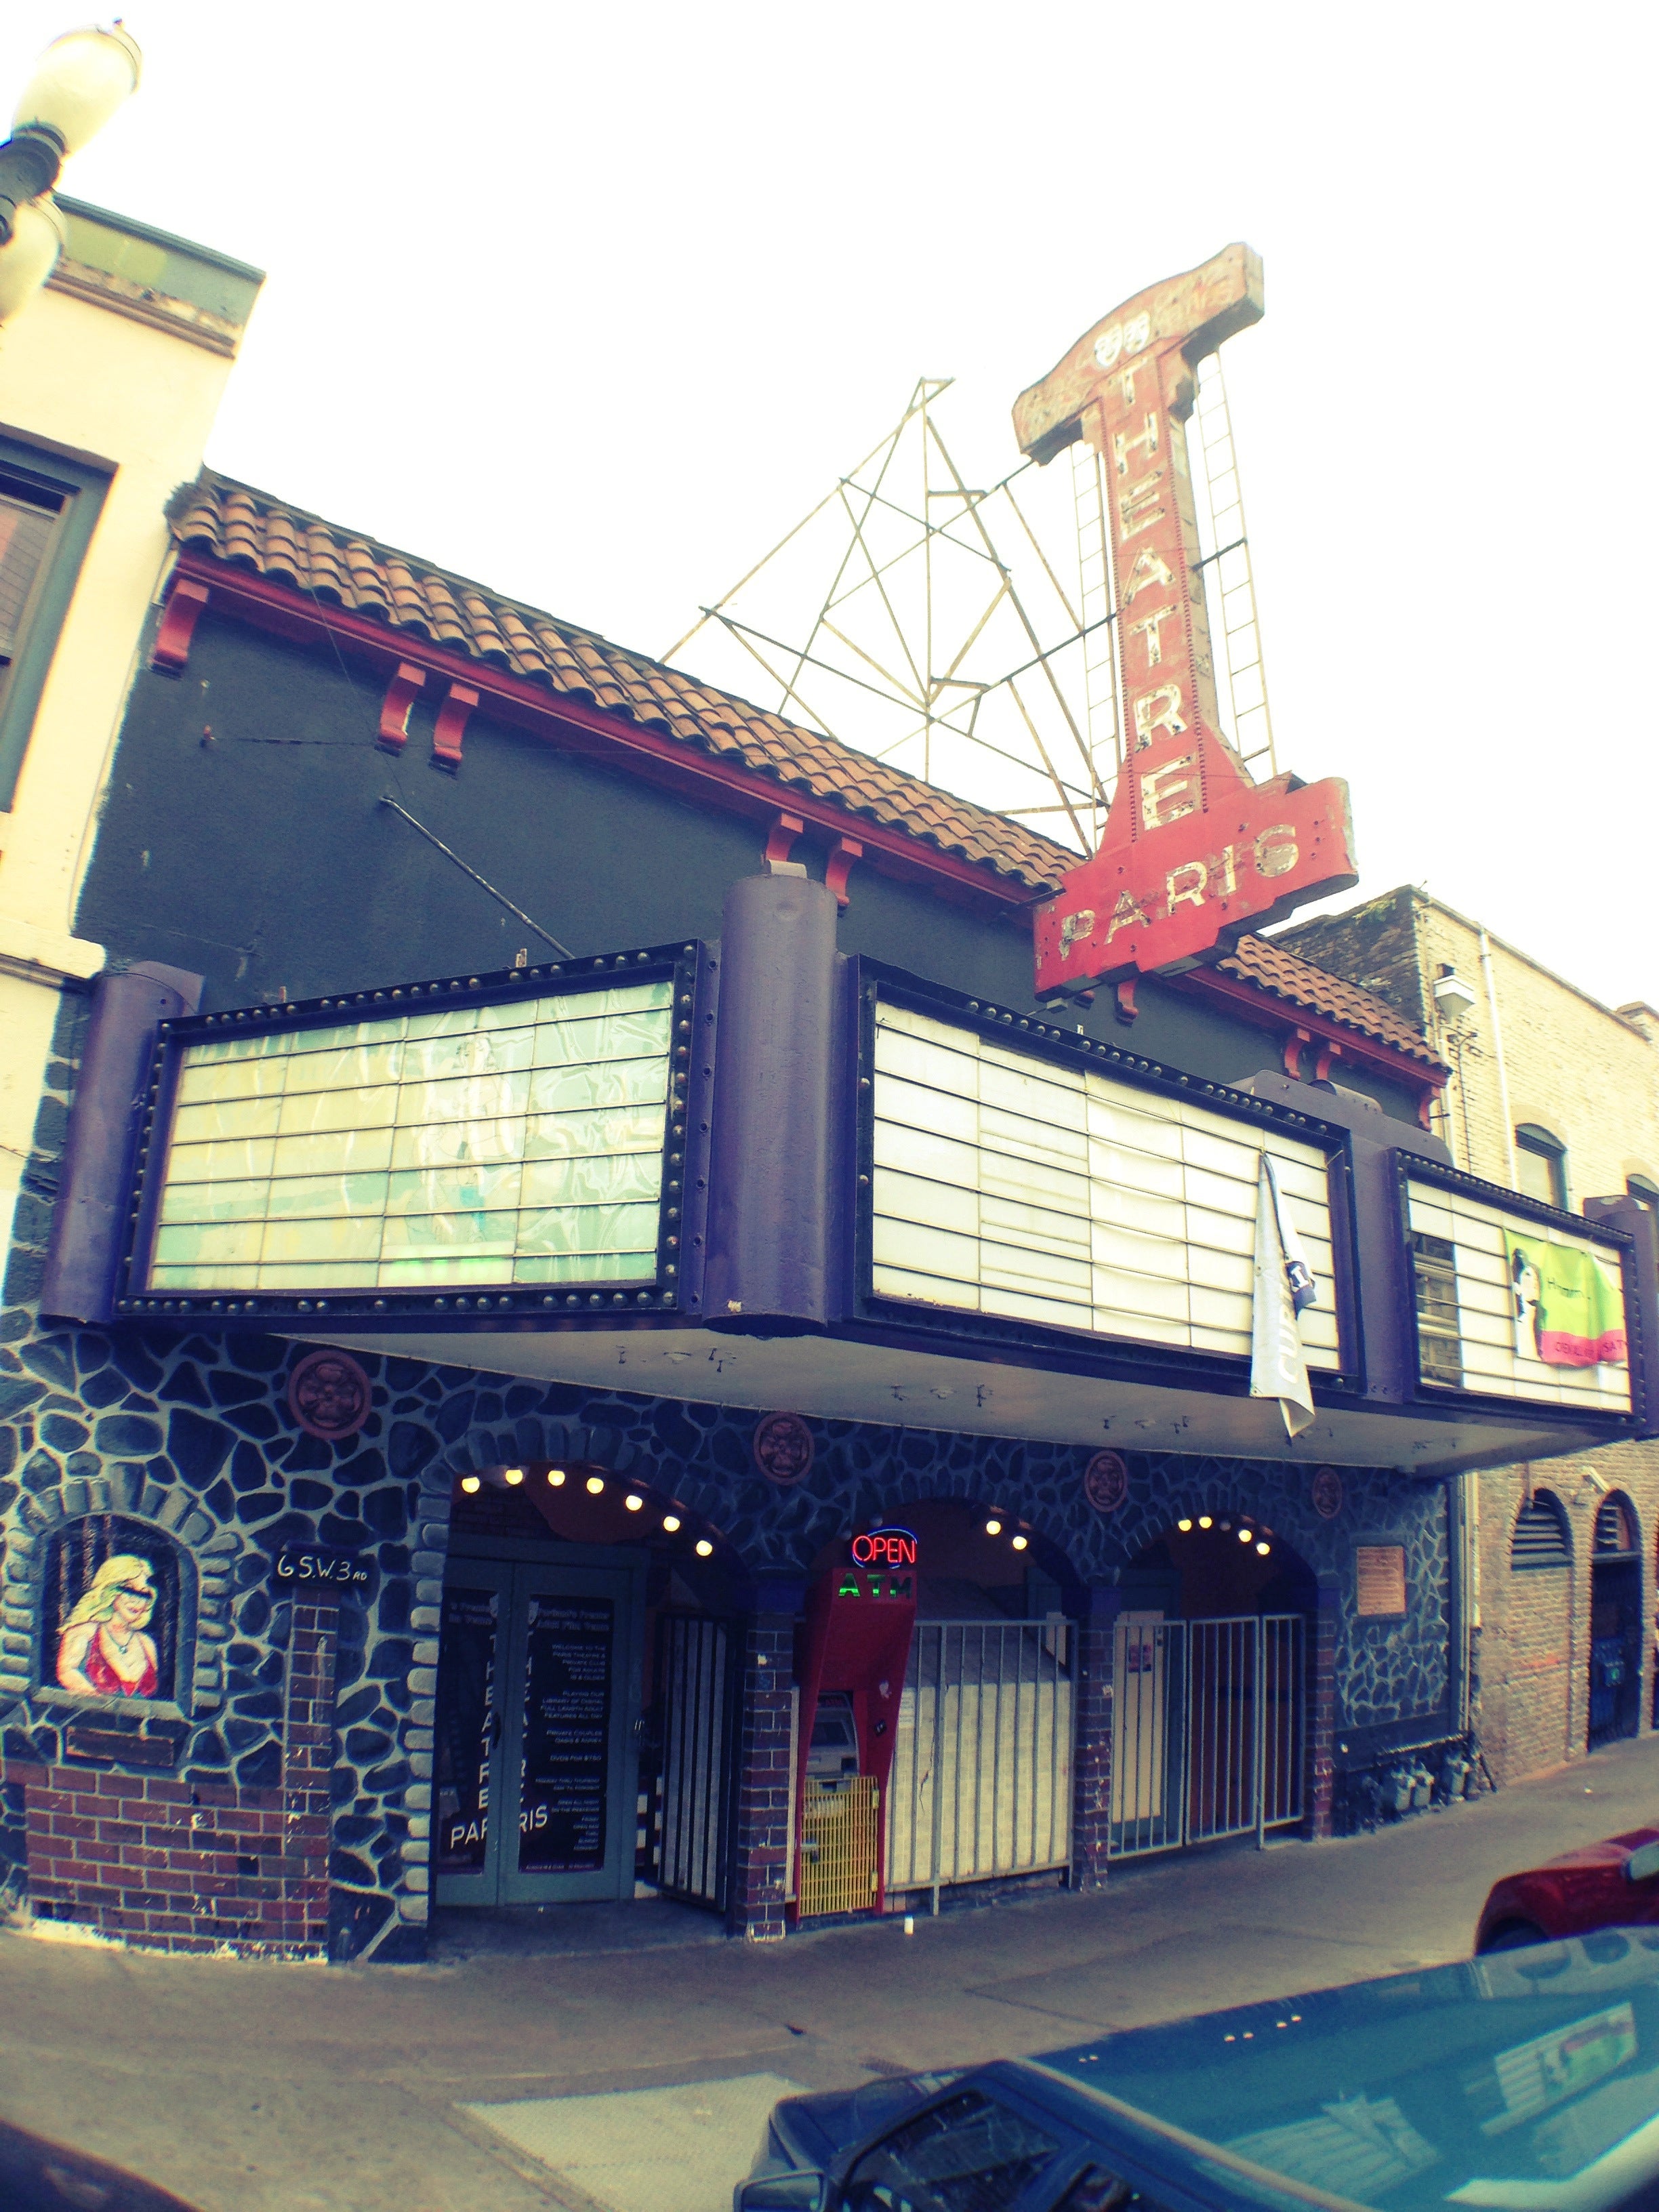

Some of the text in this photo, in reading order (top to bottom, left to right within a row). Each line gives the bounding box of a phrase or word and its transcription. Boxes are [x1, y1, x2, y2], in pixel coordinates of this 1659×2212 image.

[1113, 354, 1196, 831] THEATRE
[1059, 824, 1300, 962] PARIS
[852, 1534, 917, 1564] OPEN
[276, 1554, 295, 1578] 6
[838, 1572, 912, 1600] ATM
